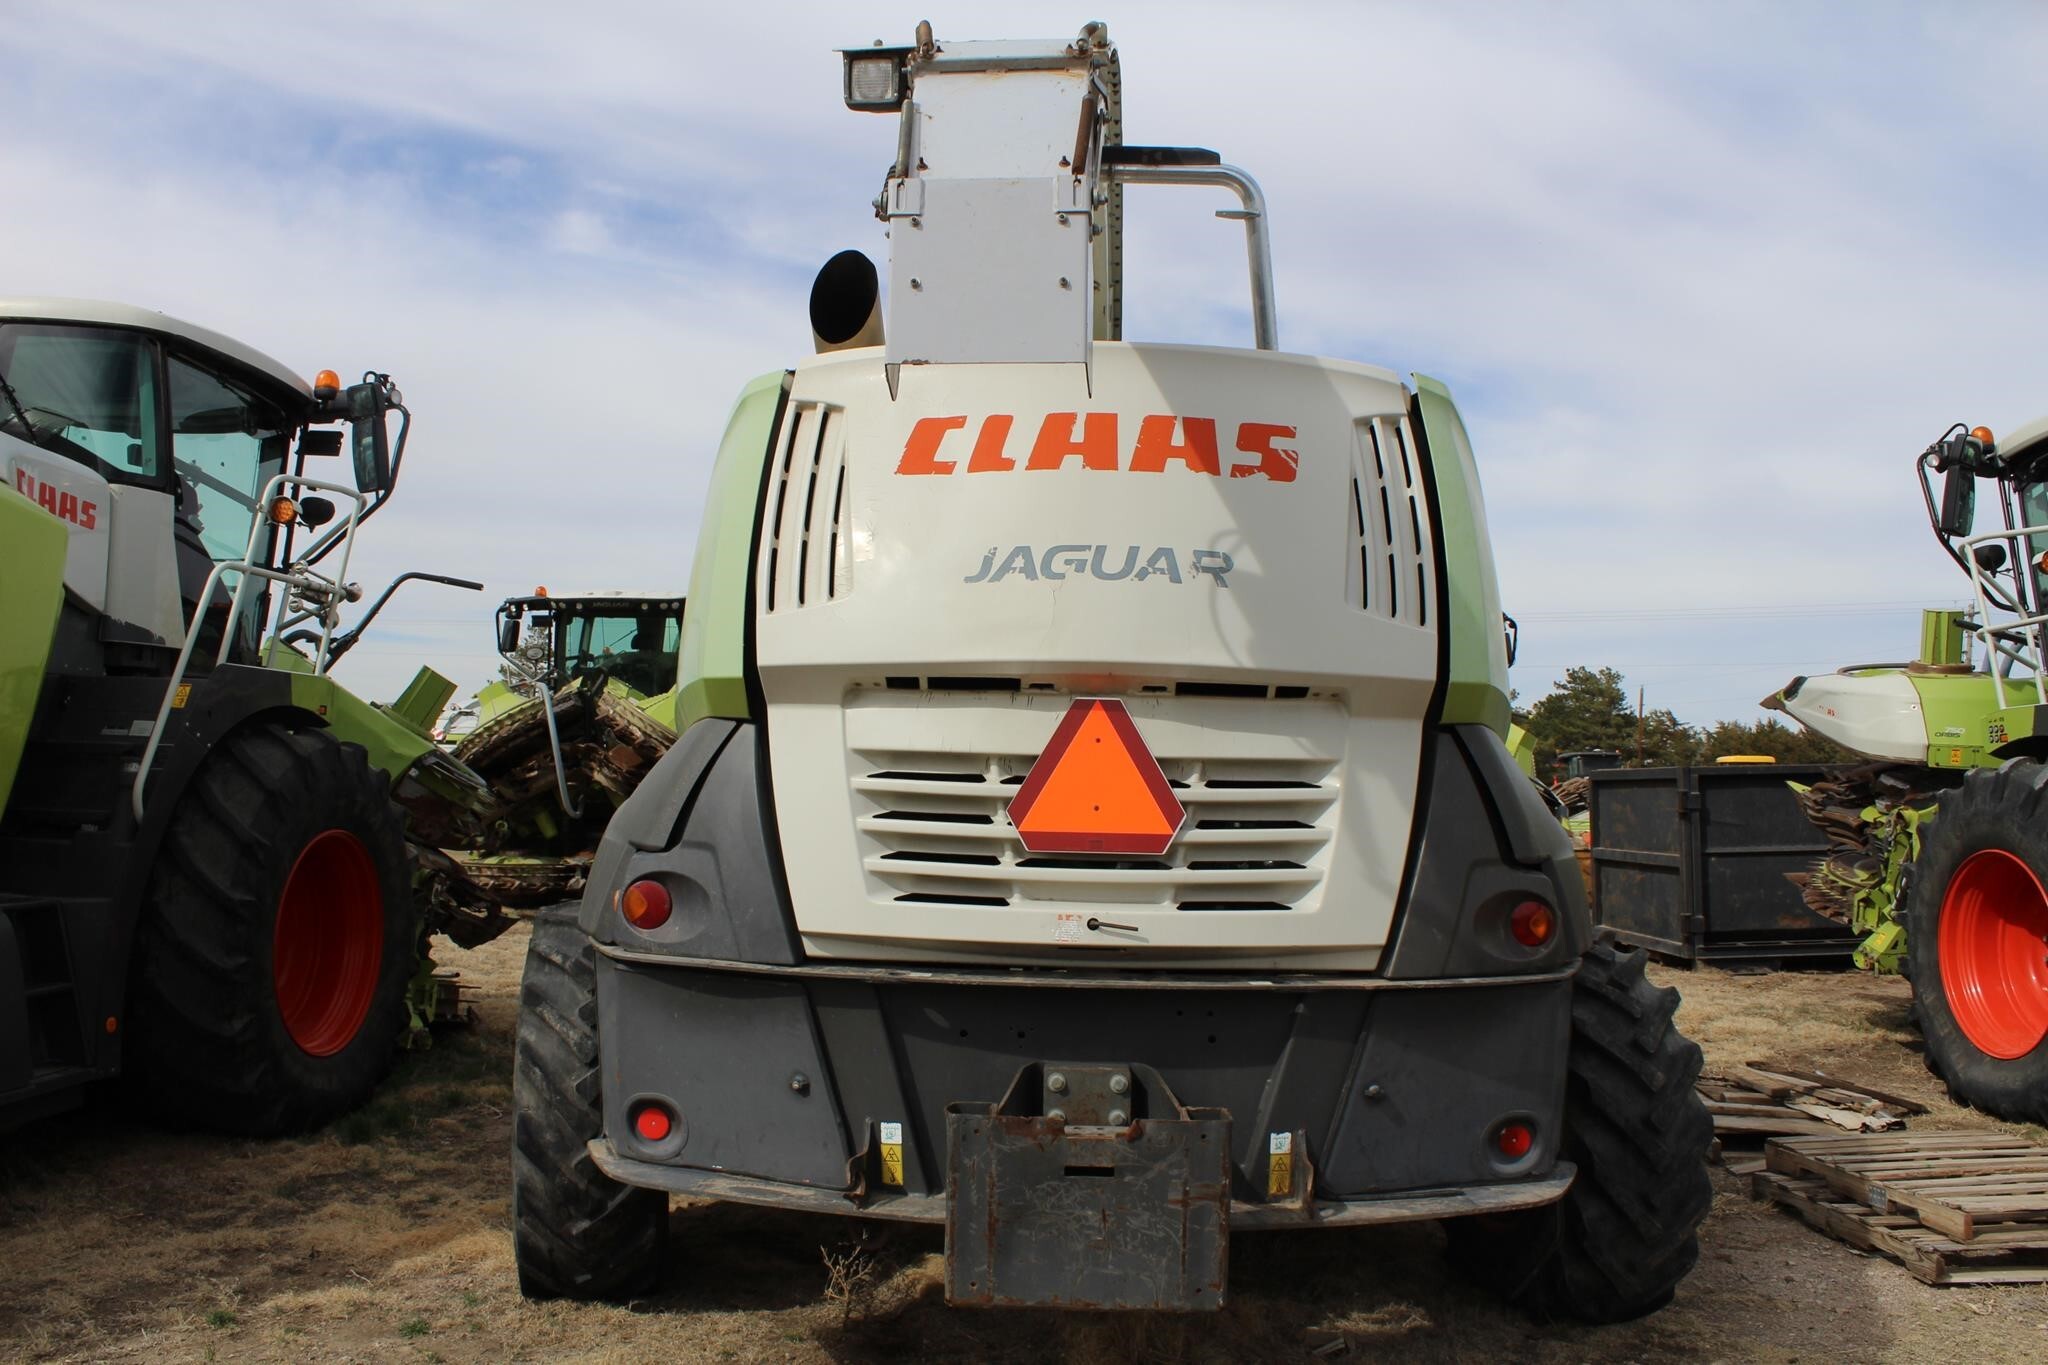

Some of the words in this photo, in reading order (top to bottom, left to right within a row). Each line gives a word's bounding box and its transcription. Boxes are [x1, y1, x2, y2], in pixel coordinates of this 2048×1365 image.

[894, 412, 1300, 483] CLAAS
[16, 467, 97, 530] CLAAS
[963, 544, 1235, 589] JAGUAR
